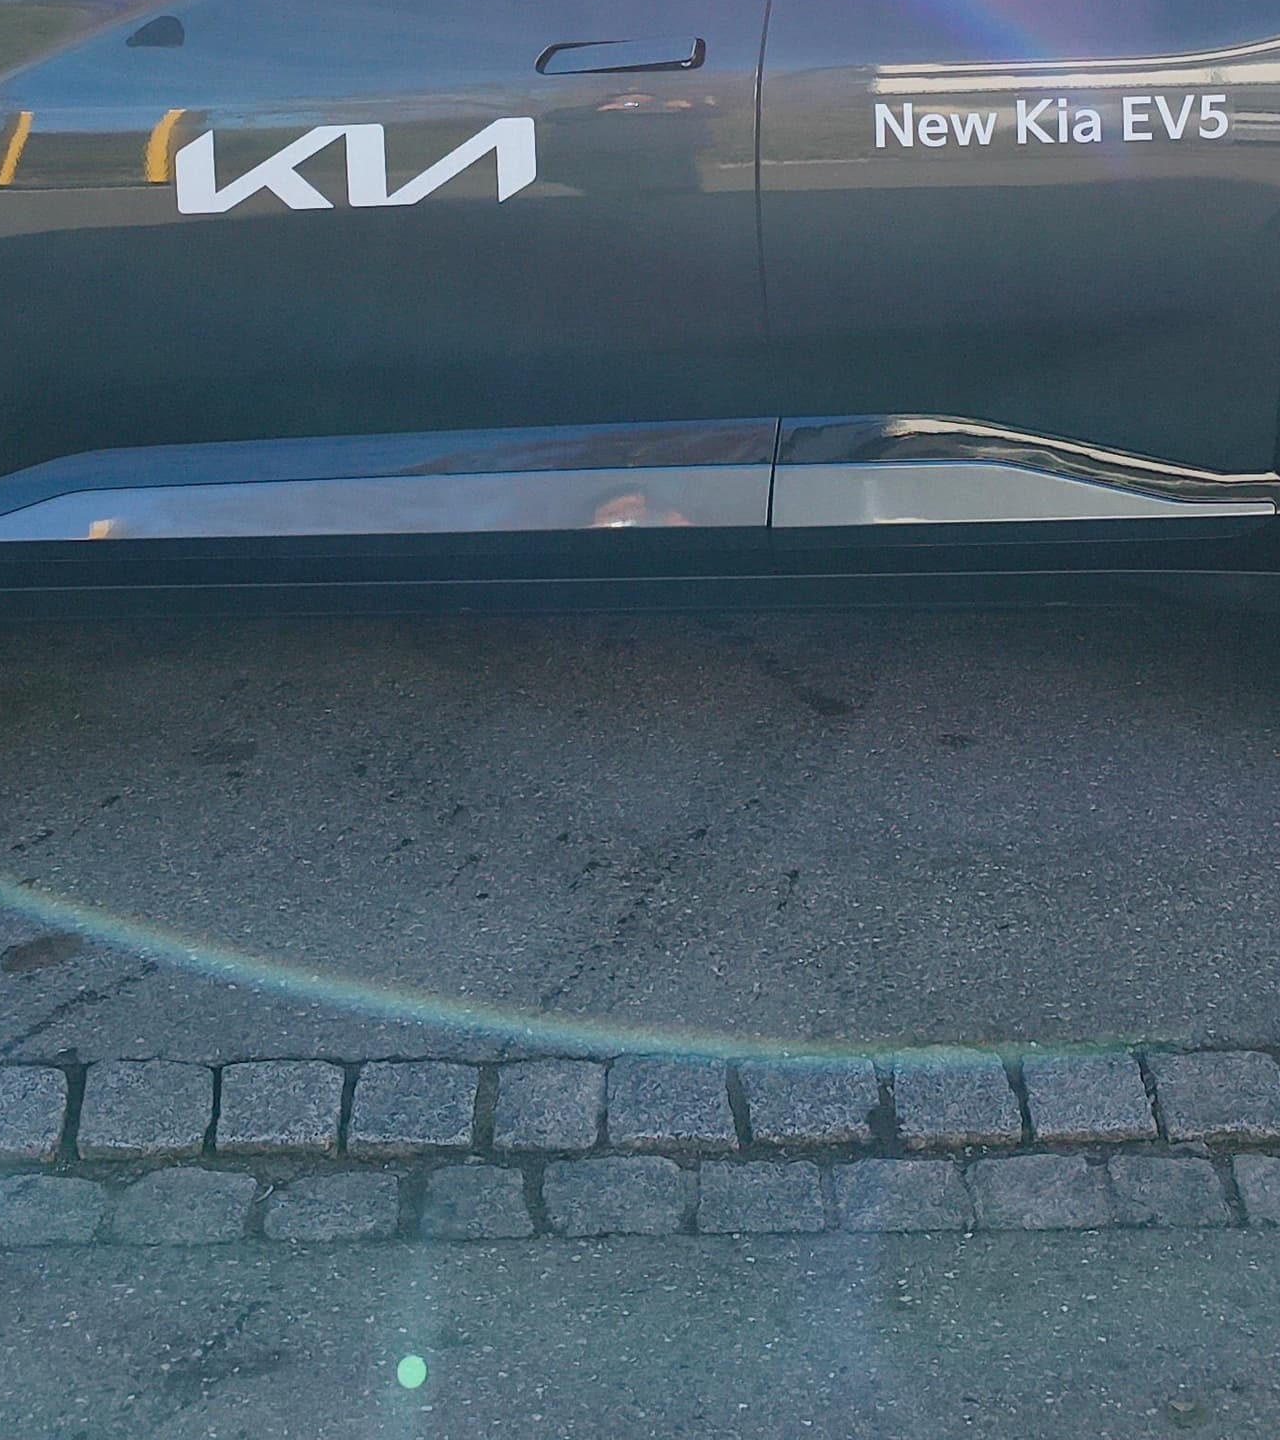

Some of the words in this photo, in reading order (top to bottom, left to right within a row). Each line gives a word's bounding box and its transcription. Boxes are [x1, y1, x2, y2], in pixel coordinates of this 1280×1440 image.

[874, 102, 998, 148] New
[1016, 98, 1102, 144] Kia
[1122, 94, 1228, 142] EV5
[175, 117, 536, 214] KIA
